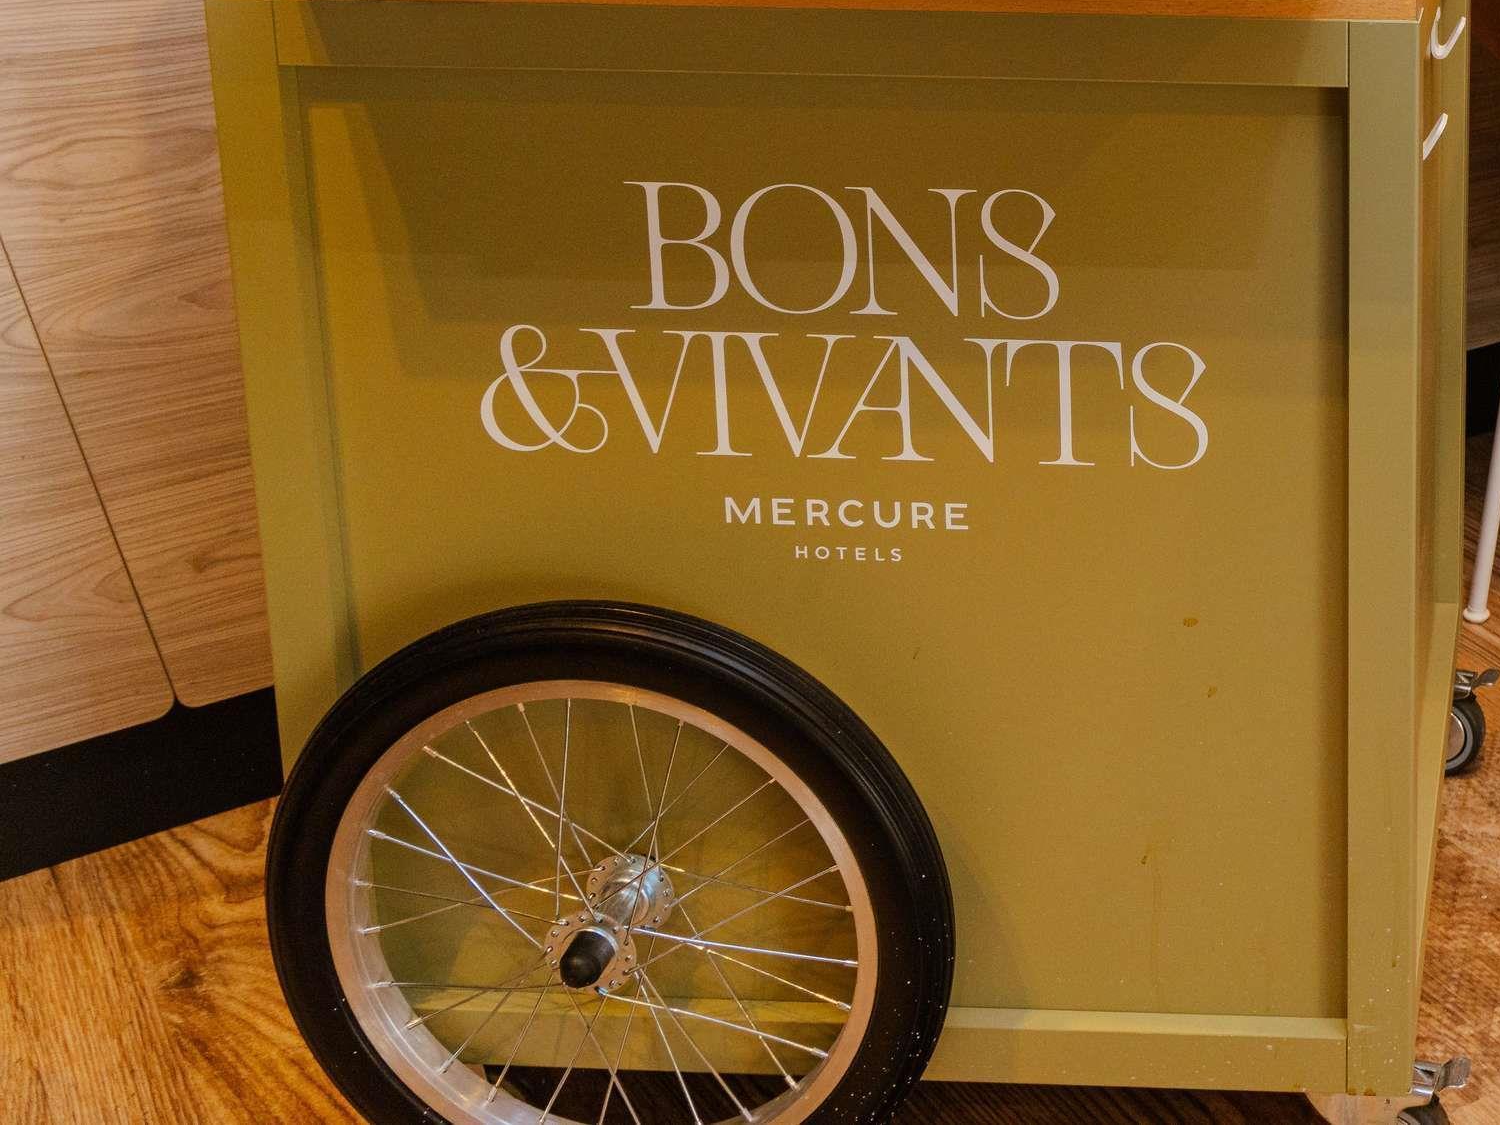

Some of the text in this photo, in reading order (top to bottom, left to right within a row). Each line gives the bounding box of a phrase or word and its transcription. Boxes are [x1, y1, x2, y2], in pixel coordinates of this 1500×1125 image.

[624, 181, 1060, 320] BONS
[724, 496, 970, 530] MERCURE
[795, 545, 903, 562] HOTELS
